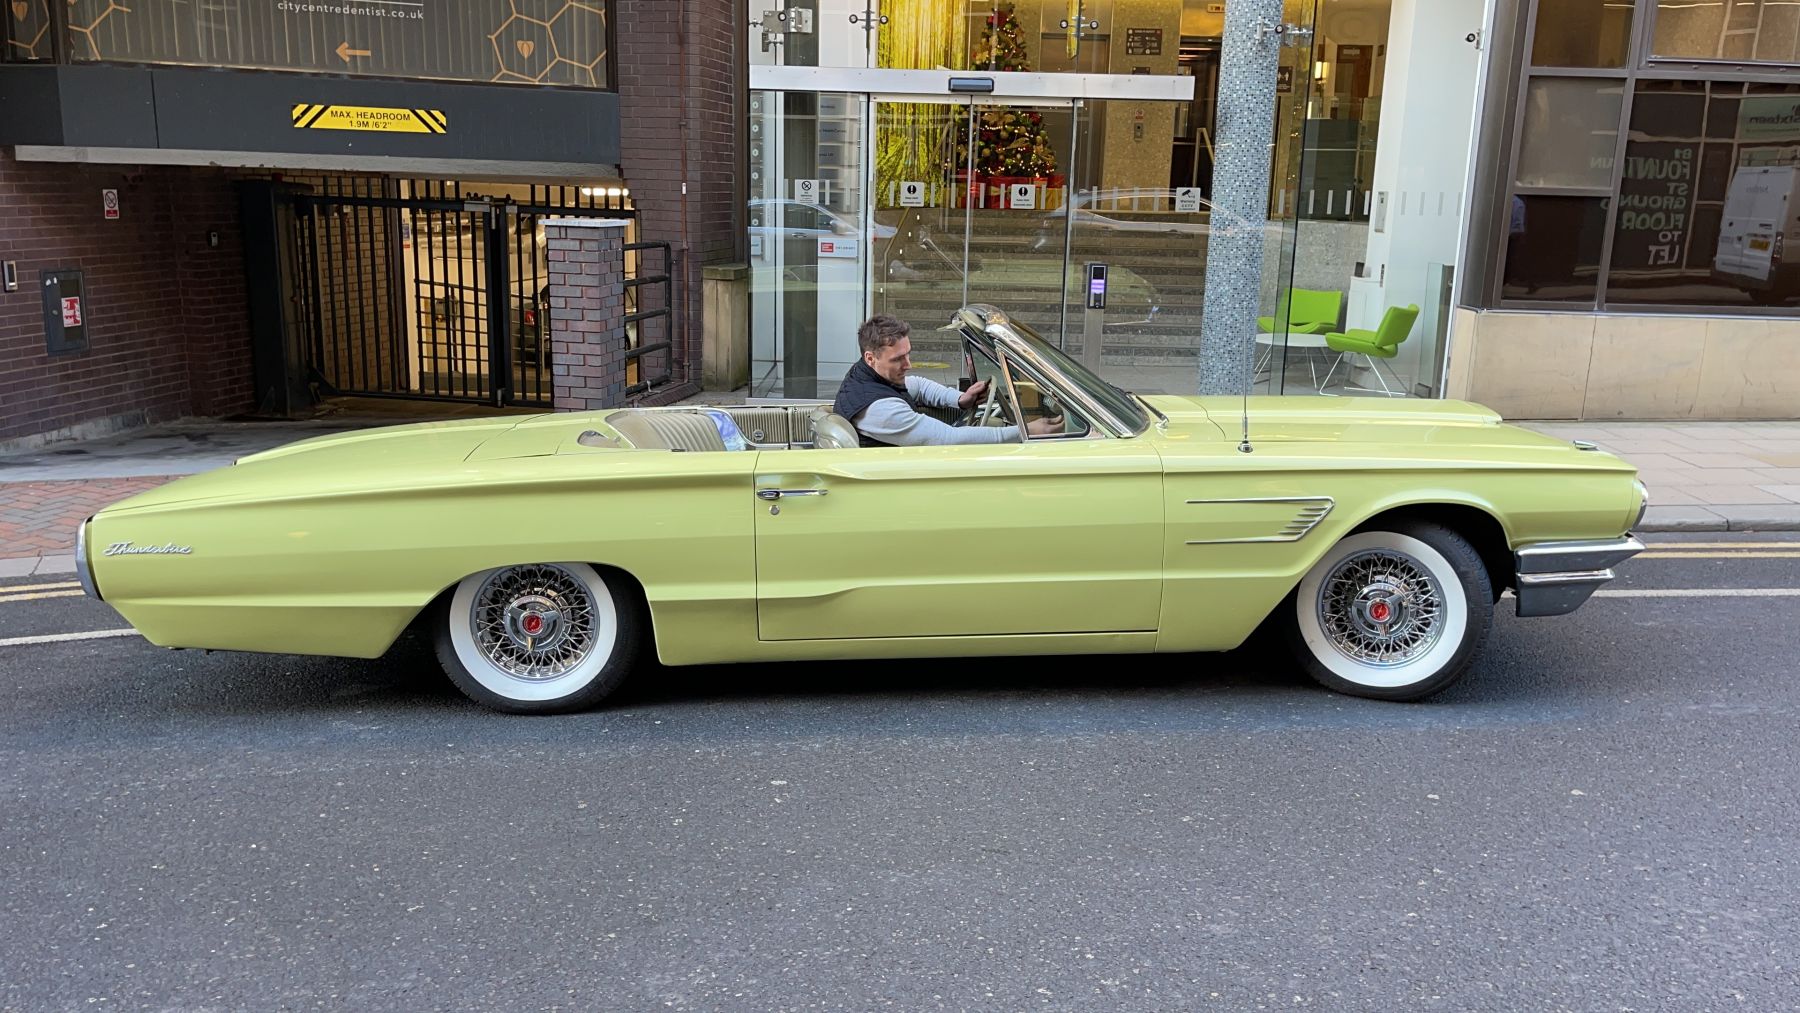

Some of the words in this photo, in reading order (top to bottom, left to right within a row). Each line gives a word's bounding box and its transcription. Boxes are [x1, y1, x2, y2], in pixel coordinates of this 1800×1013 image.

[277, 2, 424, 20] citycentredentist.co.uk
[330, 110, 354, 119] MAX.
[356, 111, 411, 121] HEADROOM
[349, 120, 370, 128] 1.9M
[102, 540, 192, 556] Thunderbird
